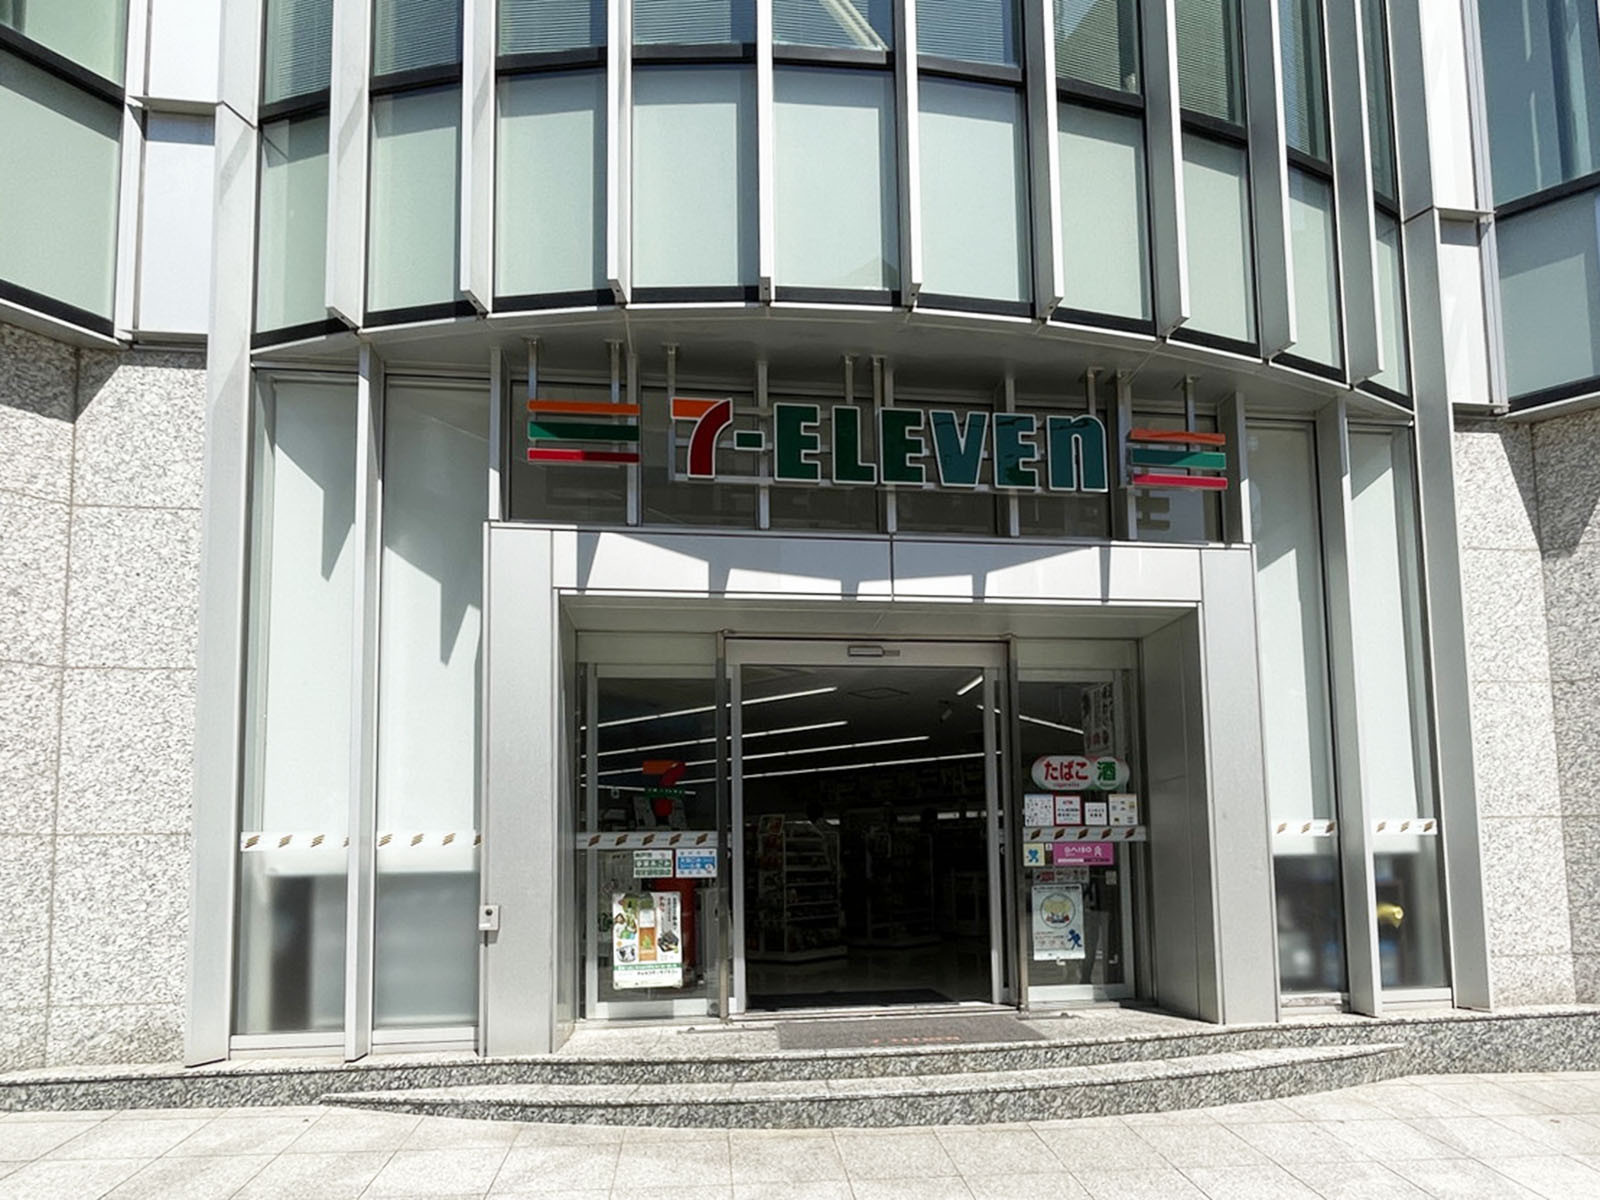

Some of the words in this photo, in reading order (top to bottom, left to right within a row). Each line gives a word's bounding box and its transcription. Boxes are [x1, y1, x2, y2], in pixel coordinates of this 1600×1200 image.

[1043, 760, 1089, 781] たばこ
[1097, 761, 1117, 781] 酒
